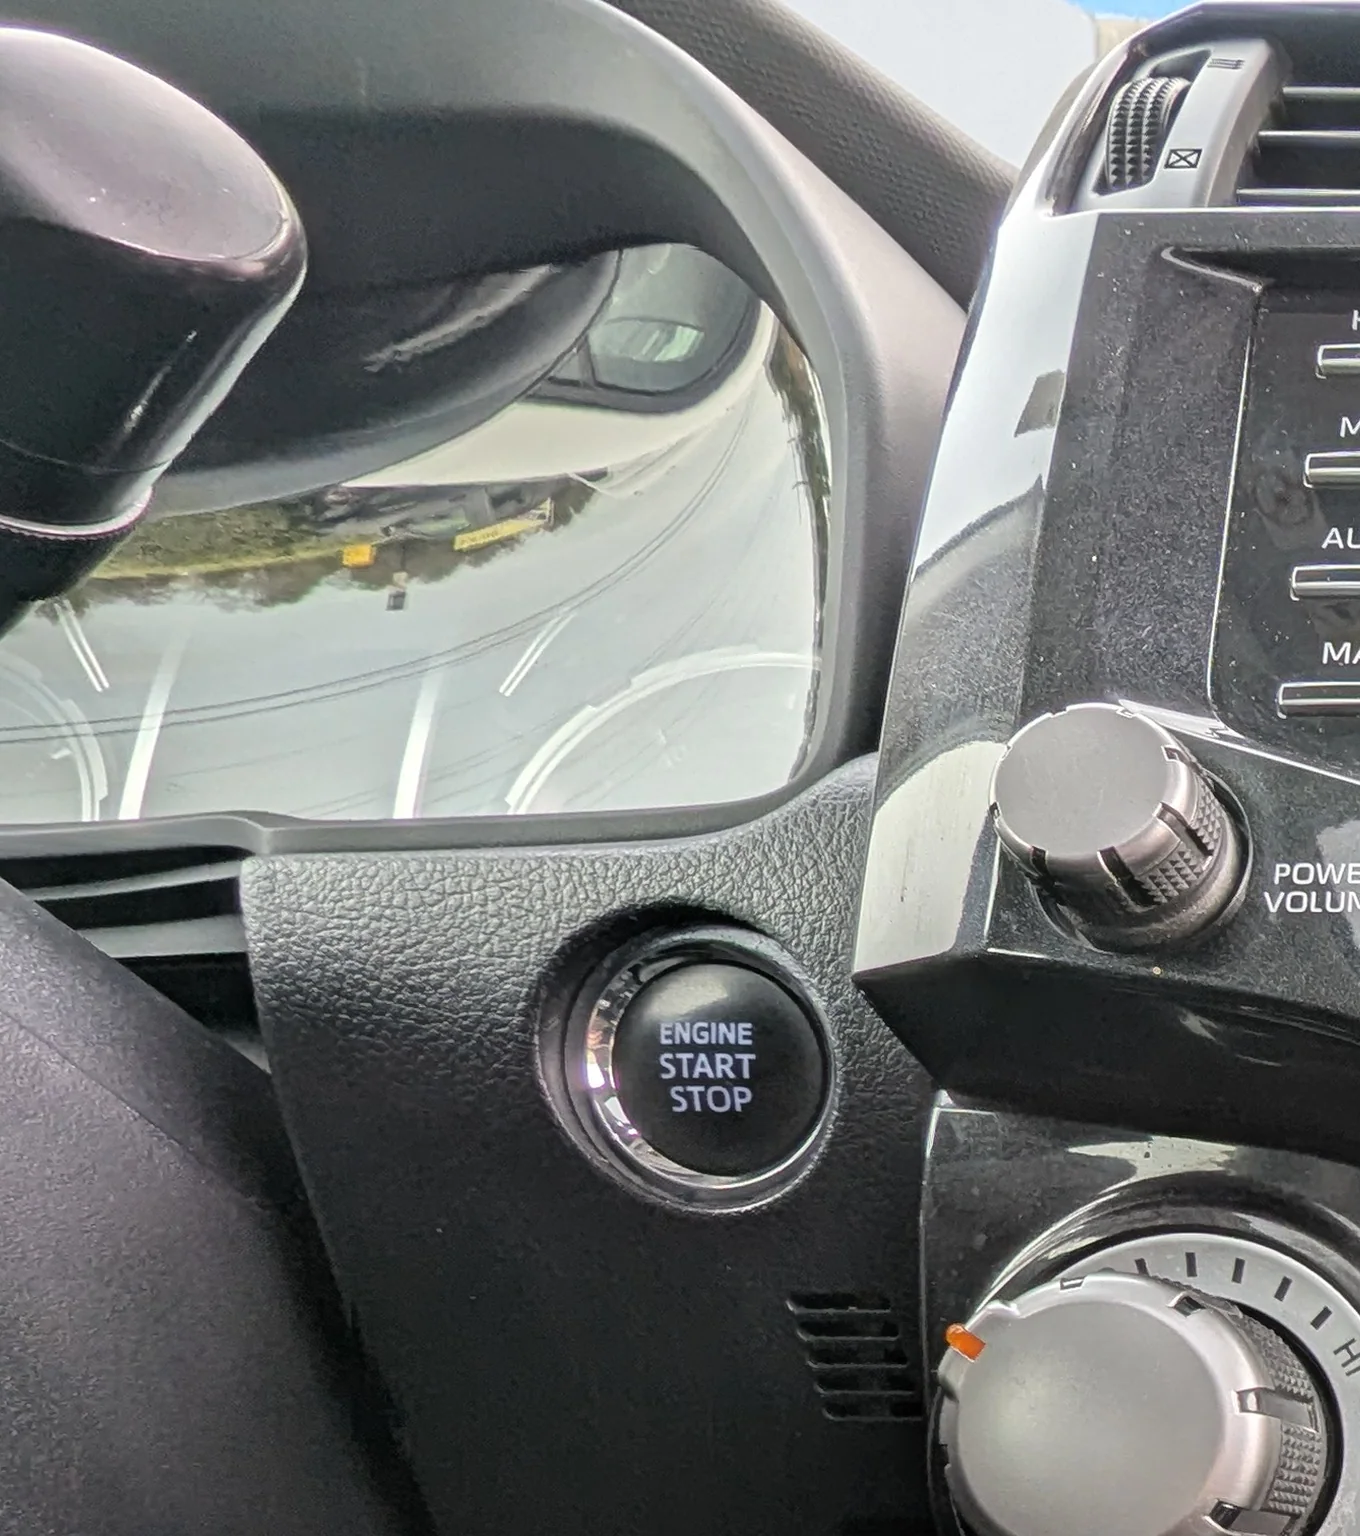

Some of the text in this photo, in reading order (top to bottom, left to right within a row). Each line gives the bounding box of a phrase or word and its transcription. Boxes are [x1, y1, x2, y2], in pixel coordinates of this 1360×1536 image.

[659, 1021, 753, 1046] ENGINE
[659, 1052, 756, 1080] START
[671, 1085, 753, 1113] STOP
